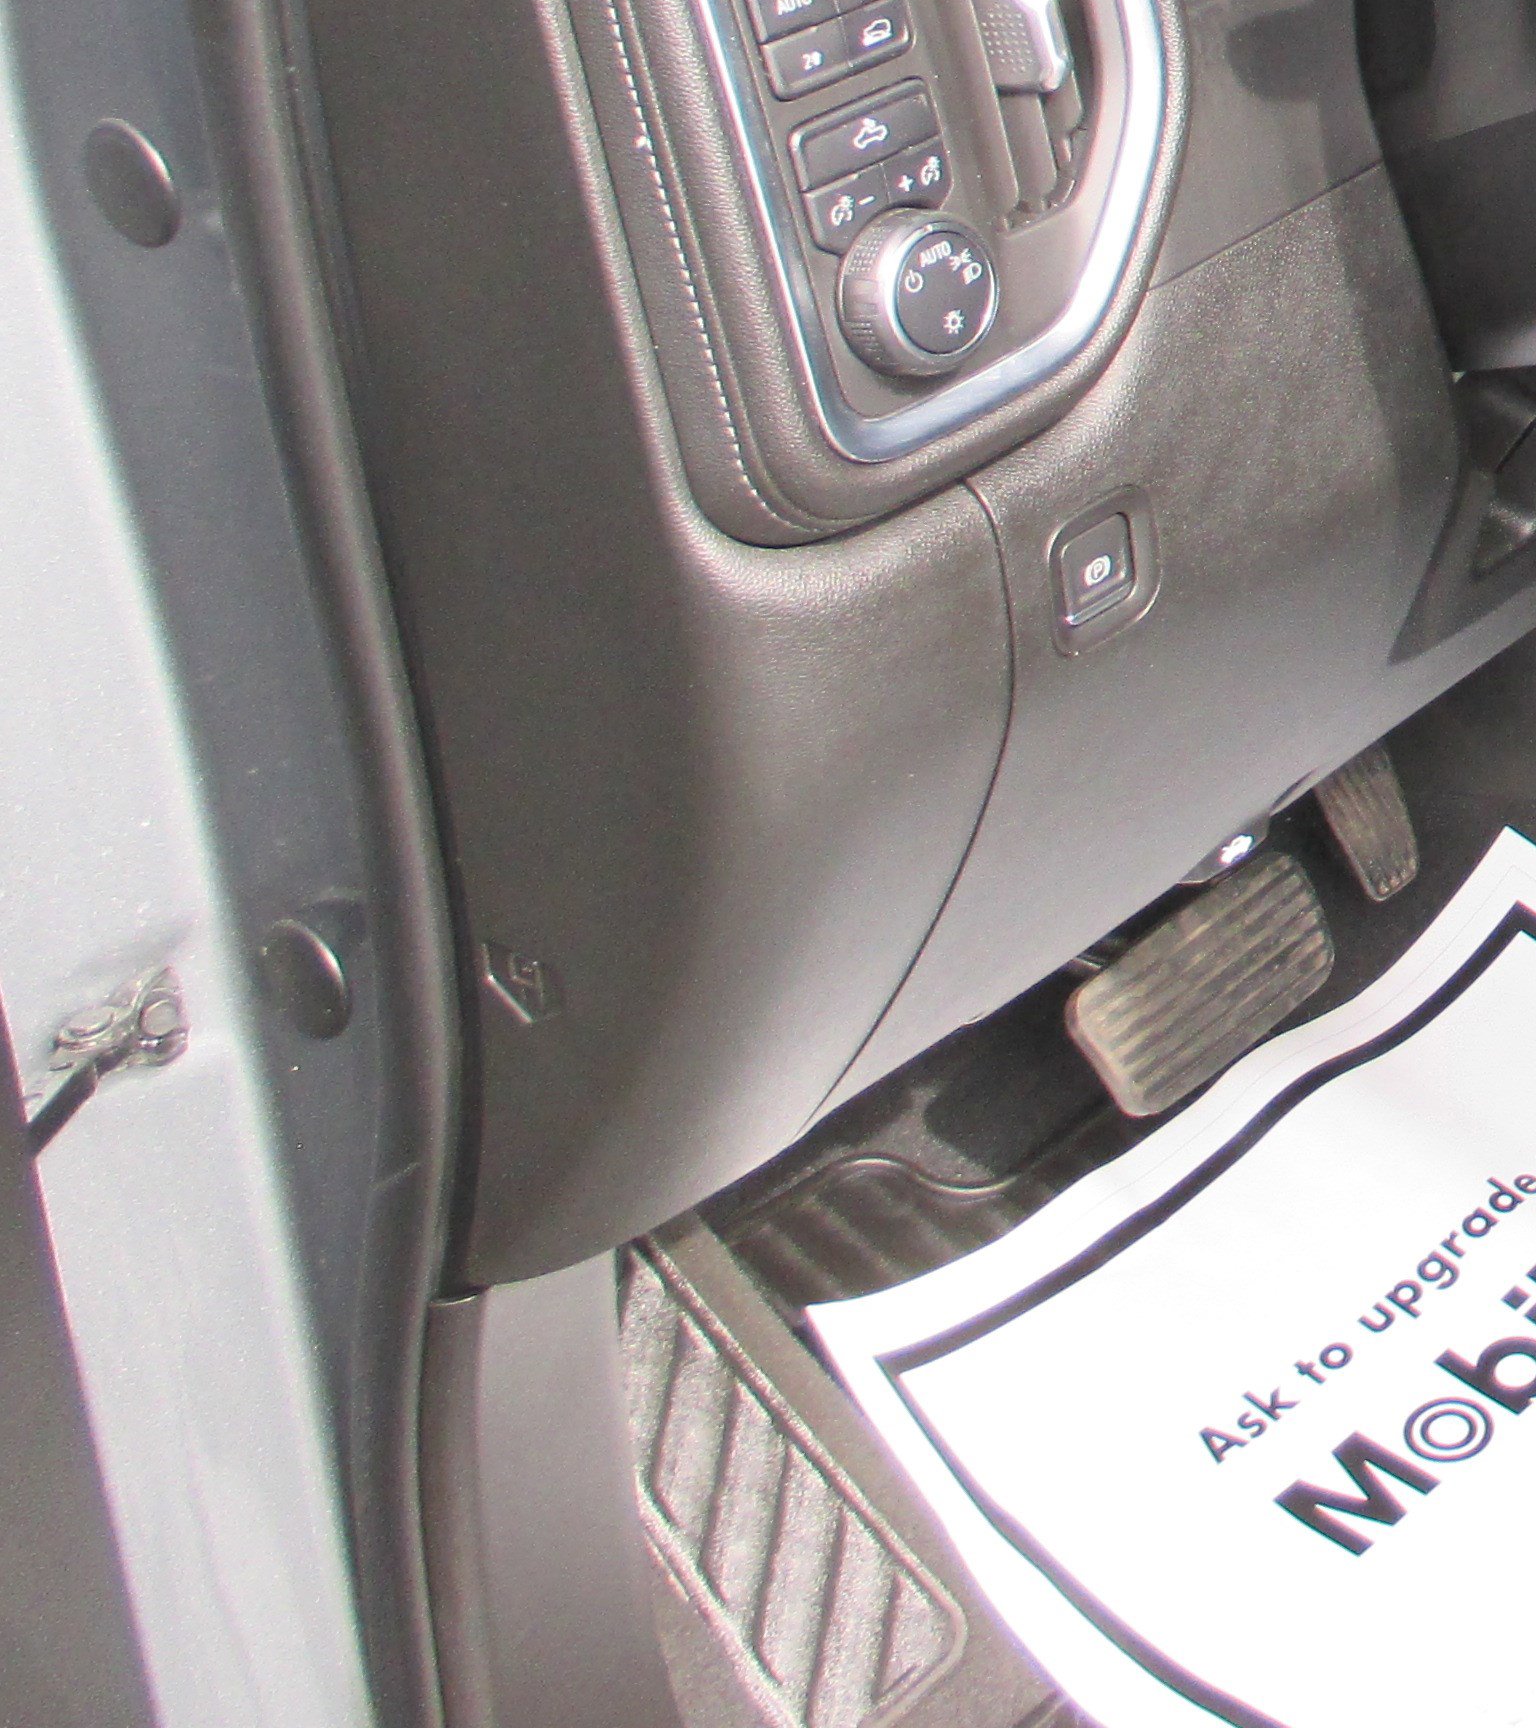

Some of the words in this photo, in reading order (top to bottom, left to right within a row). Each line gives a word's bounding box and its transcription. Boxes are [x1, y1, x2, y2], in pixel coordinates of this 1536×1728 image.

[920, 240, 952, 268] AUTO
[1199, 1387, 1301, 1464] Ask
[1294, 1342, 1354, 1385] to
